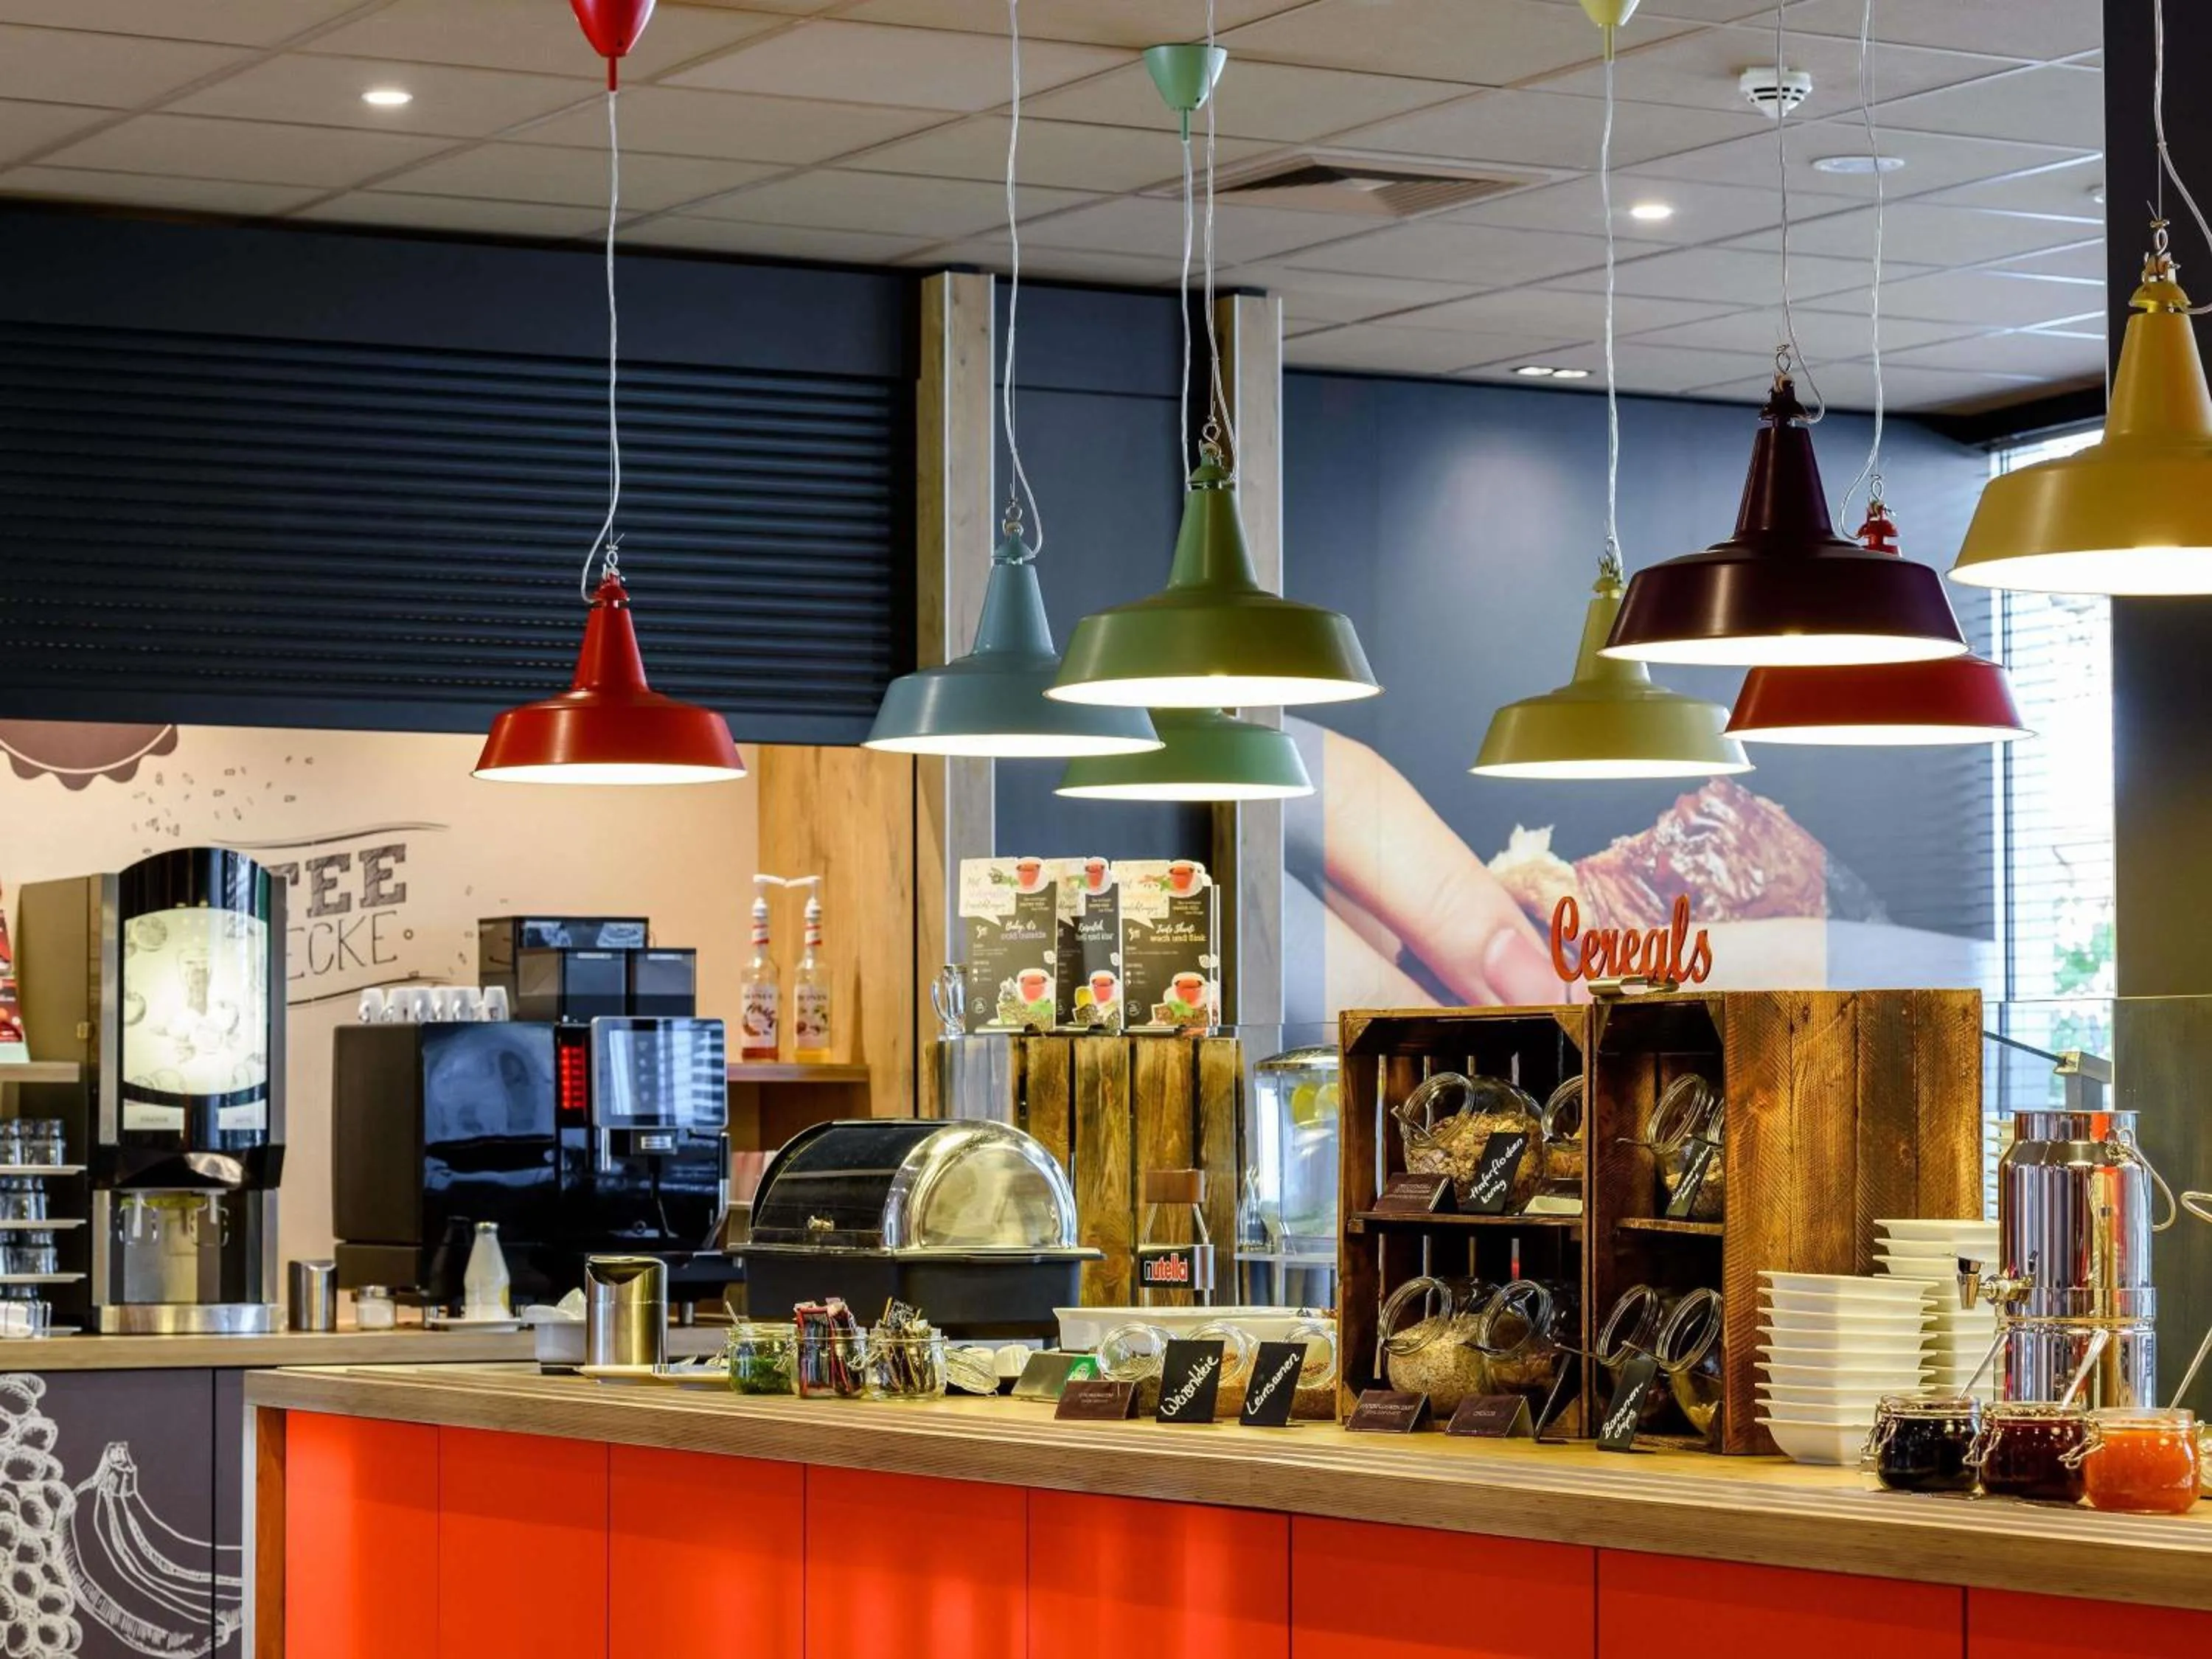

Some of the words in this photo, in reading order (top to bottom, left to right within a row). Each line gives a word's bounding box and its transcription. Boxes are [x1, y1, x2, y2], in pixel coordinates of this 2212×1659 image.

[1551, 893, 1712, 984] Cereals
[1144, 1253, 1188, 1282] nutella
[1246, 1352, 1300, 1415] Leinsamen
